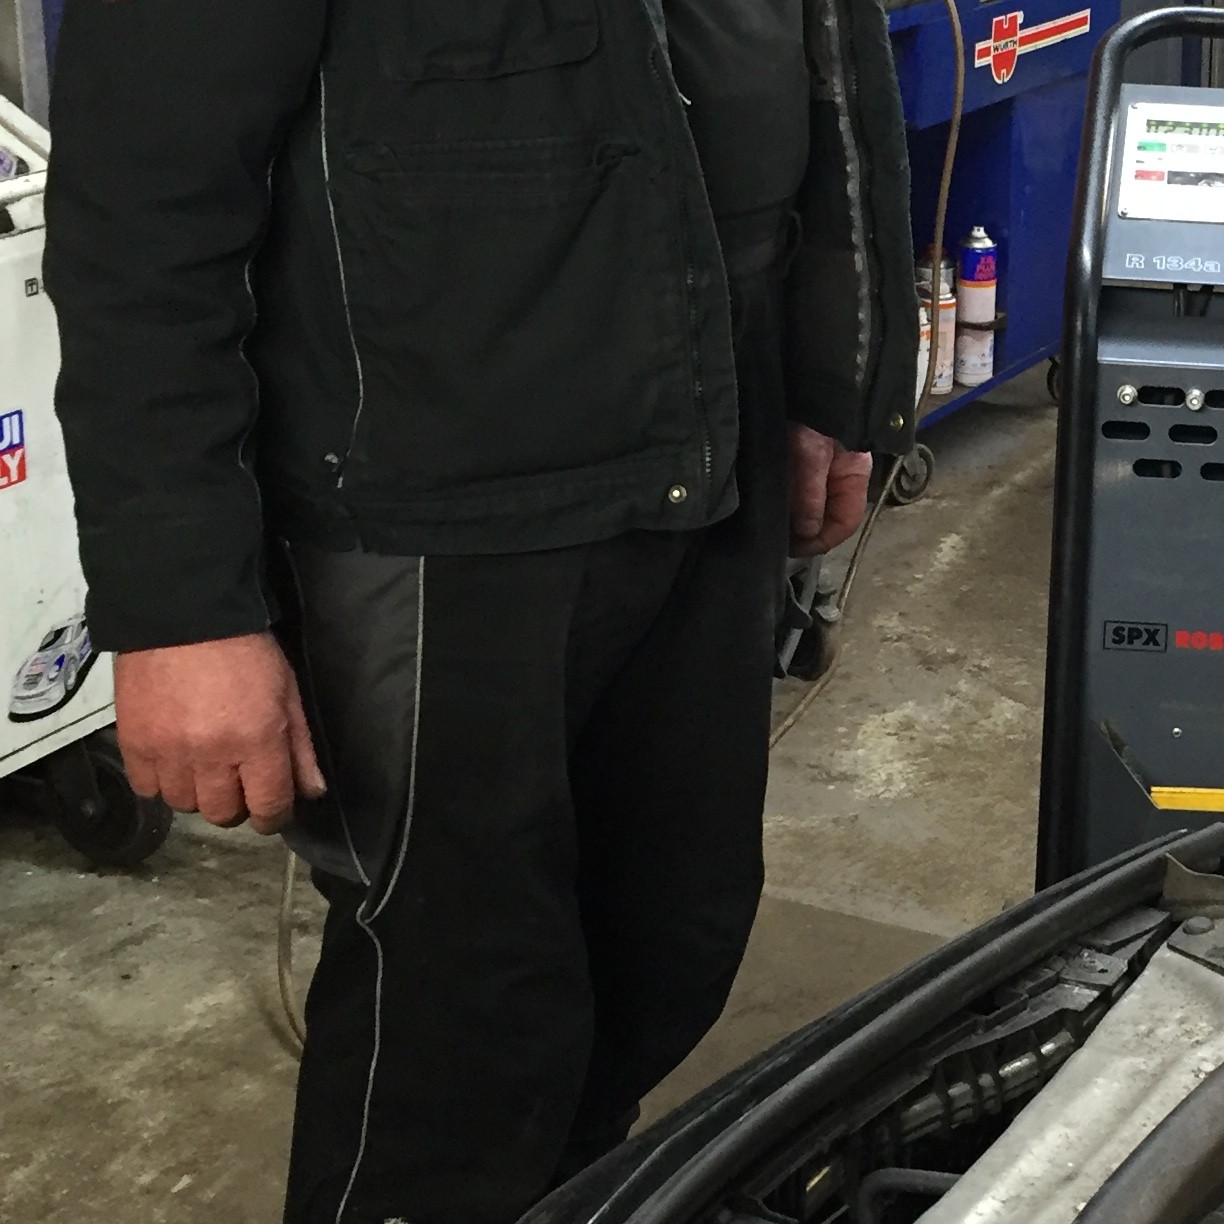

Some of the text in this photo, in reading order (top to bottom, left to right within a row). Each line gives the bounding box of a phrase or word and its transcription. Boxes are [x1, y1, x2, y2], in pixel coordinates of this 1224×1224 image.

[1125, 253, 1221, 273] R 134a
[1111, 625, 1161, 647] SPX
